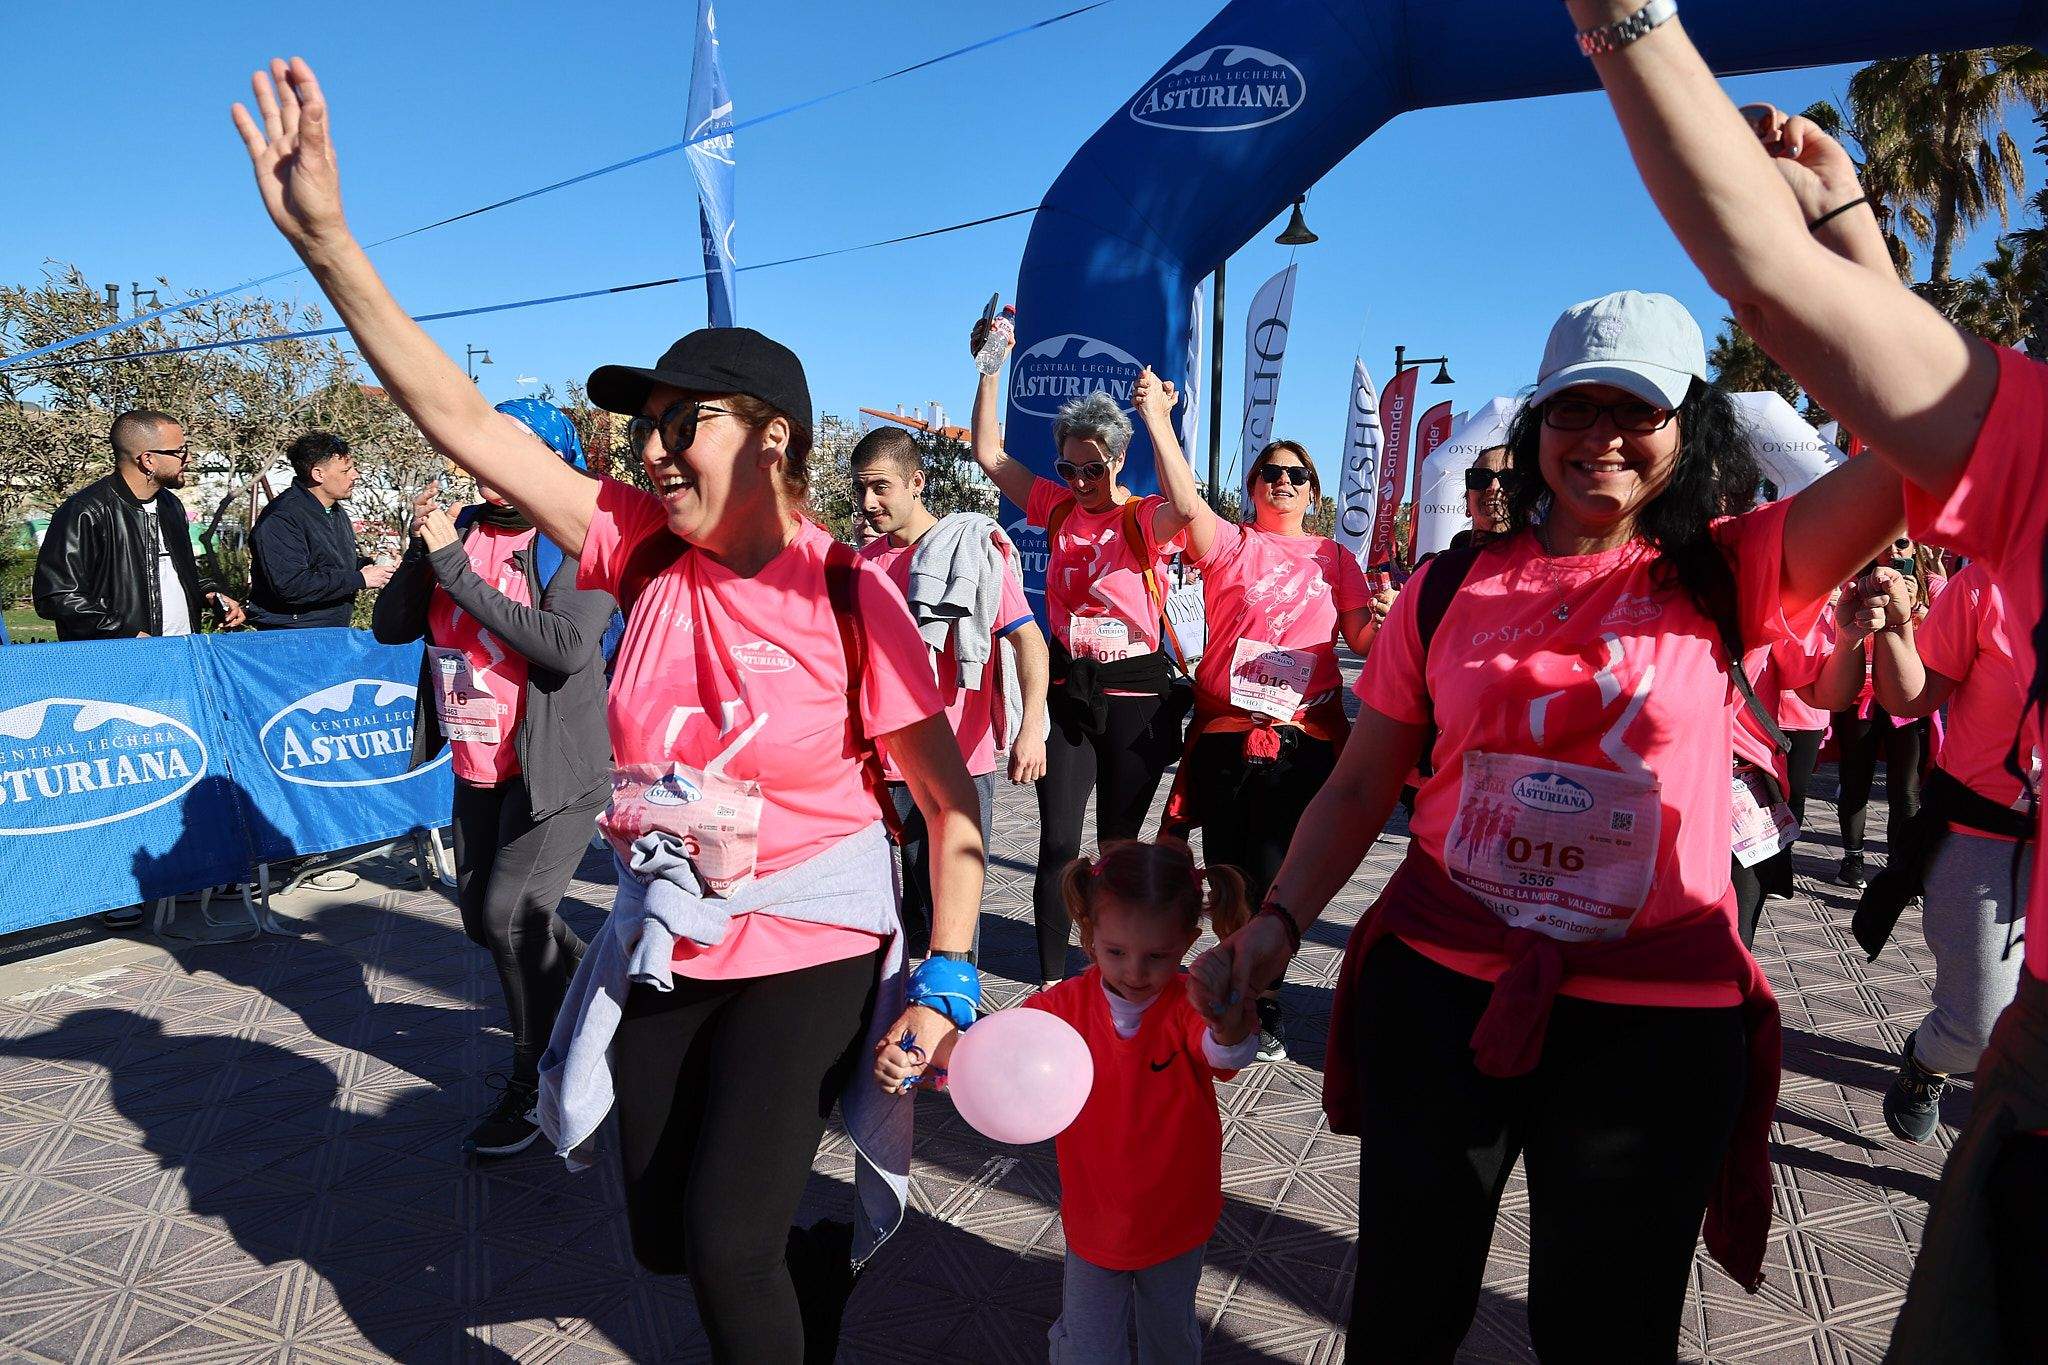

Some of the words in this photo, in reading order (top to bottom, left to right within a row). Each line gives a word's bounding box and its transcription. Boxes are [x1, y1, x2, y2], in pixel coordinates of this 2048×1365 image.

[1168, 71, 1221, 88] CENTRAL
[1226, 69, 1287, 80] LECHERA
[1138, 85, 1290, 116] ASTURIANA
[1030, 363, 1077, 372] CENTRAL
[1082, 364, 1137, 377] LECHERA
[1385, 394, 1405, 478] Santander
[1763, 441, 1817, 453] OYSHO
[1016, 538, 1048, 548] CENTR
[1099, 650, 1128, 662] 016
[1258, 674, 1289, 690] 016
[443, 691, 468, 706] 16
[311, 715, 380, 732] CENTRAL
[0, 743, 79, 764] ENTRAL
[87, 731, 176, 752] LECHERA
[1516, 781, 1587, 809] ASTURIANA
[1506, 837, 1585, 872] 016
[1518, 872, 1555, 887] 3536
[1466, 877, 1502, 894] CARRERA
[1503, 887, 1515, 897] DE
[1516, 889, 1529, 899] LA
[1568, 896, 1614, 917] VALENCIA
